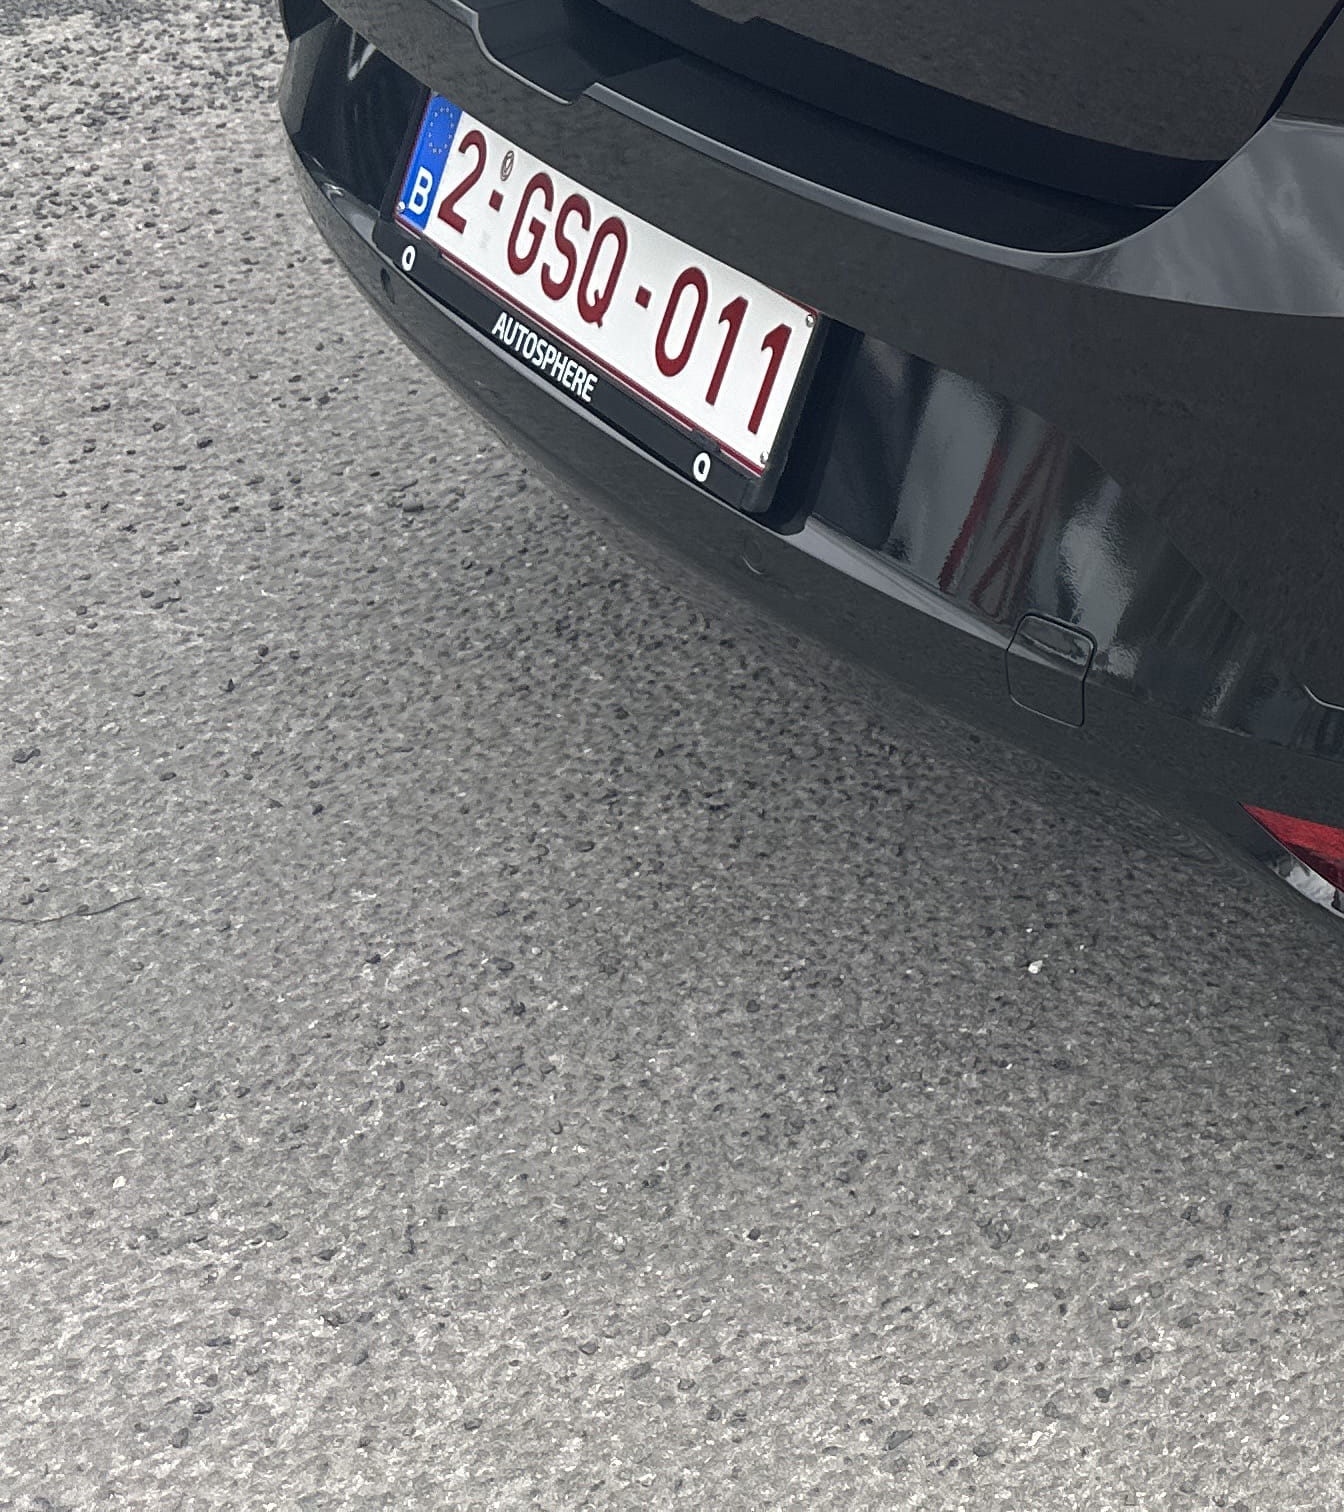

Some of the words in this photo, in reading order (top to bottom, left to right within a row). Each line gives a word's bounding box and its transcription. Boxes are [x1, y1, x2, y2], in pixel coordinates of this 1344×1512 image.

[409, 168, 434, 216] B
[437, 129, 792, 435] 2-GSQ-011
[492, 312, 598, 403] AUTOSPHERE
